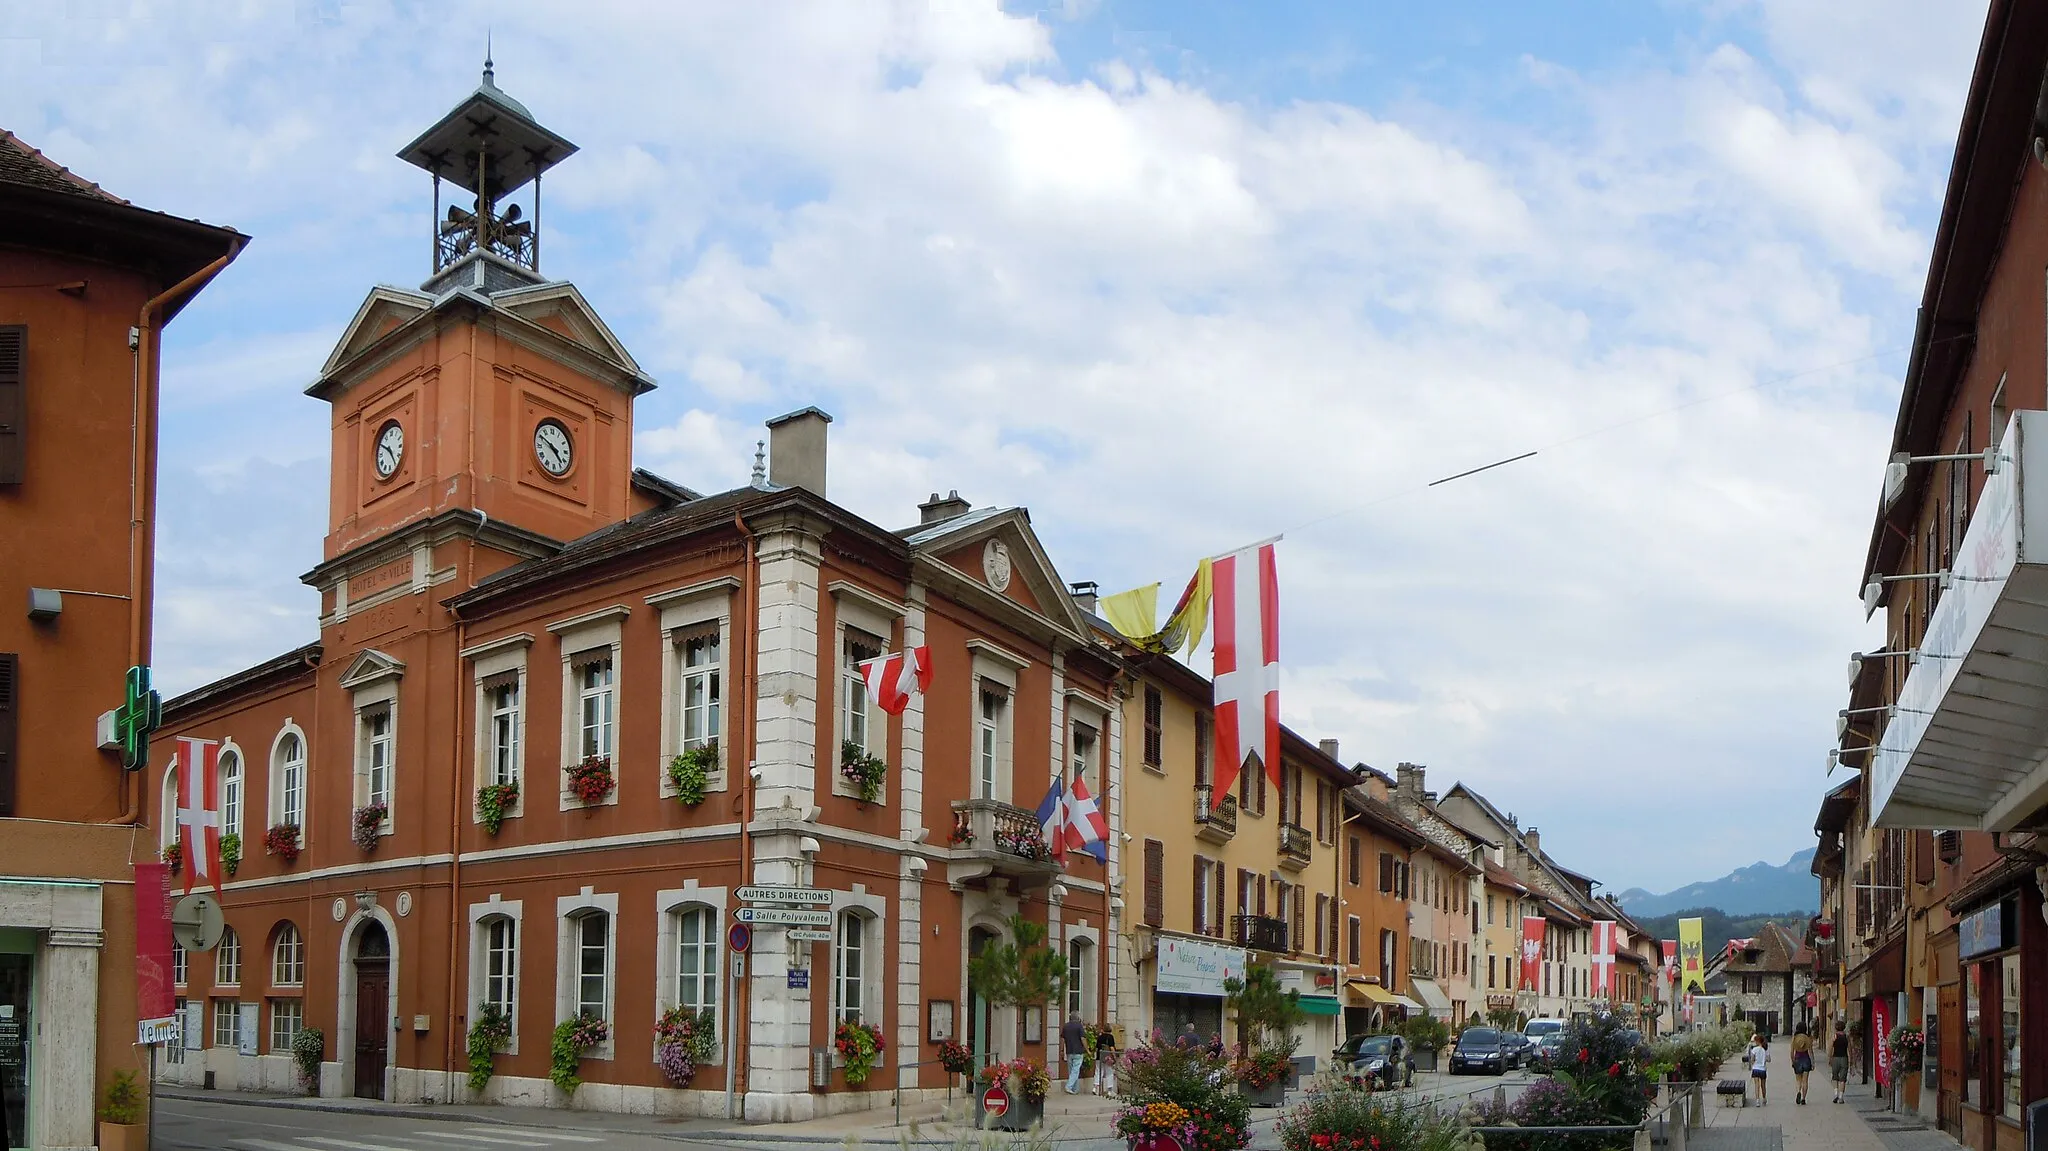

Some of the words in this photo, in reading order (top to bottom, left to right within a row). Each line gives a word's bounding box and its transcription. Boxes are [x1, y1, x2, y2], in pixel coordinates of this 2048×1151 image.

[389, 561, 411, 579] VILLE
[743, 890, 776, 899] AUTRES
[779, 892, 829, 901] DIRECTIONS
[336, 901, 342, 916] R
[400, 896, 407, 911] F
[756, 911, 777, 920] Salle
[781, 912, 829, 922] Polyvalente
